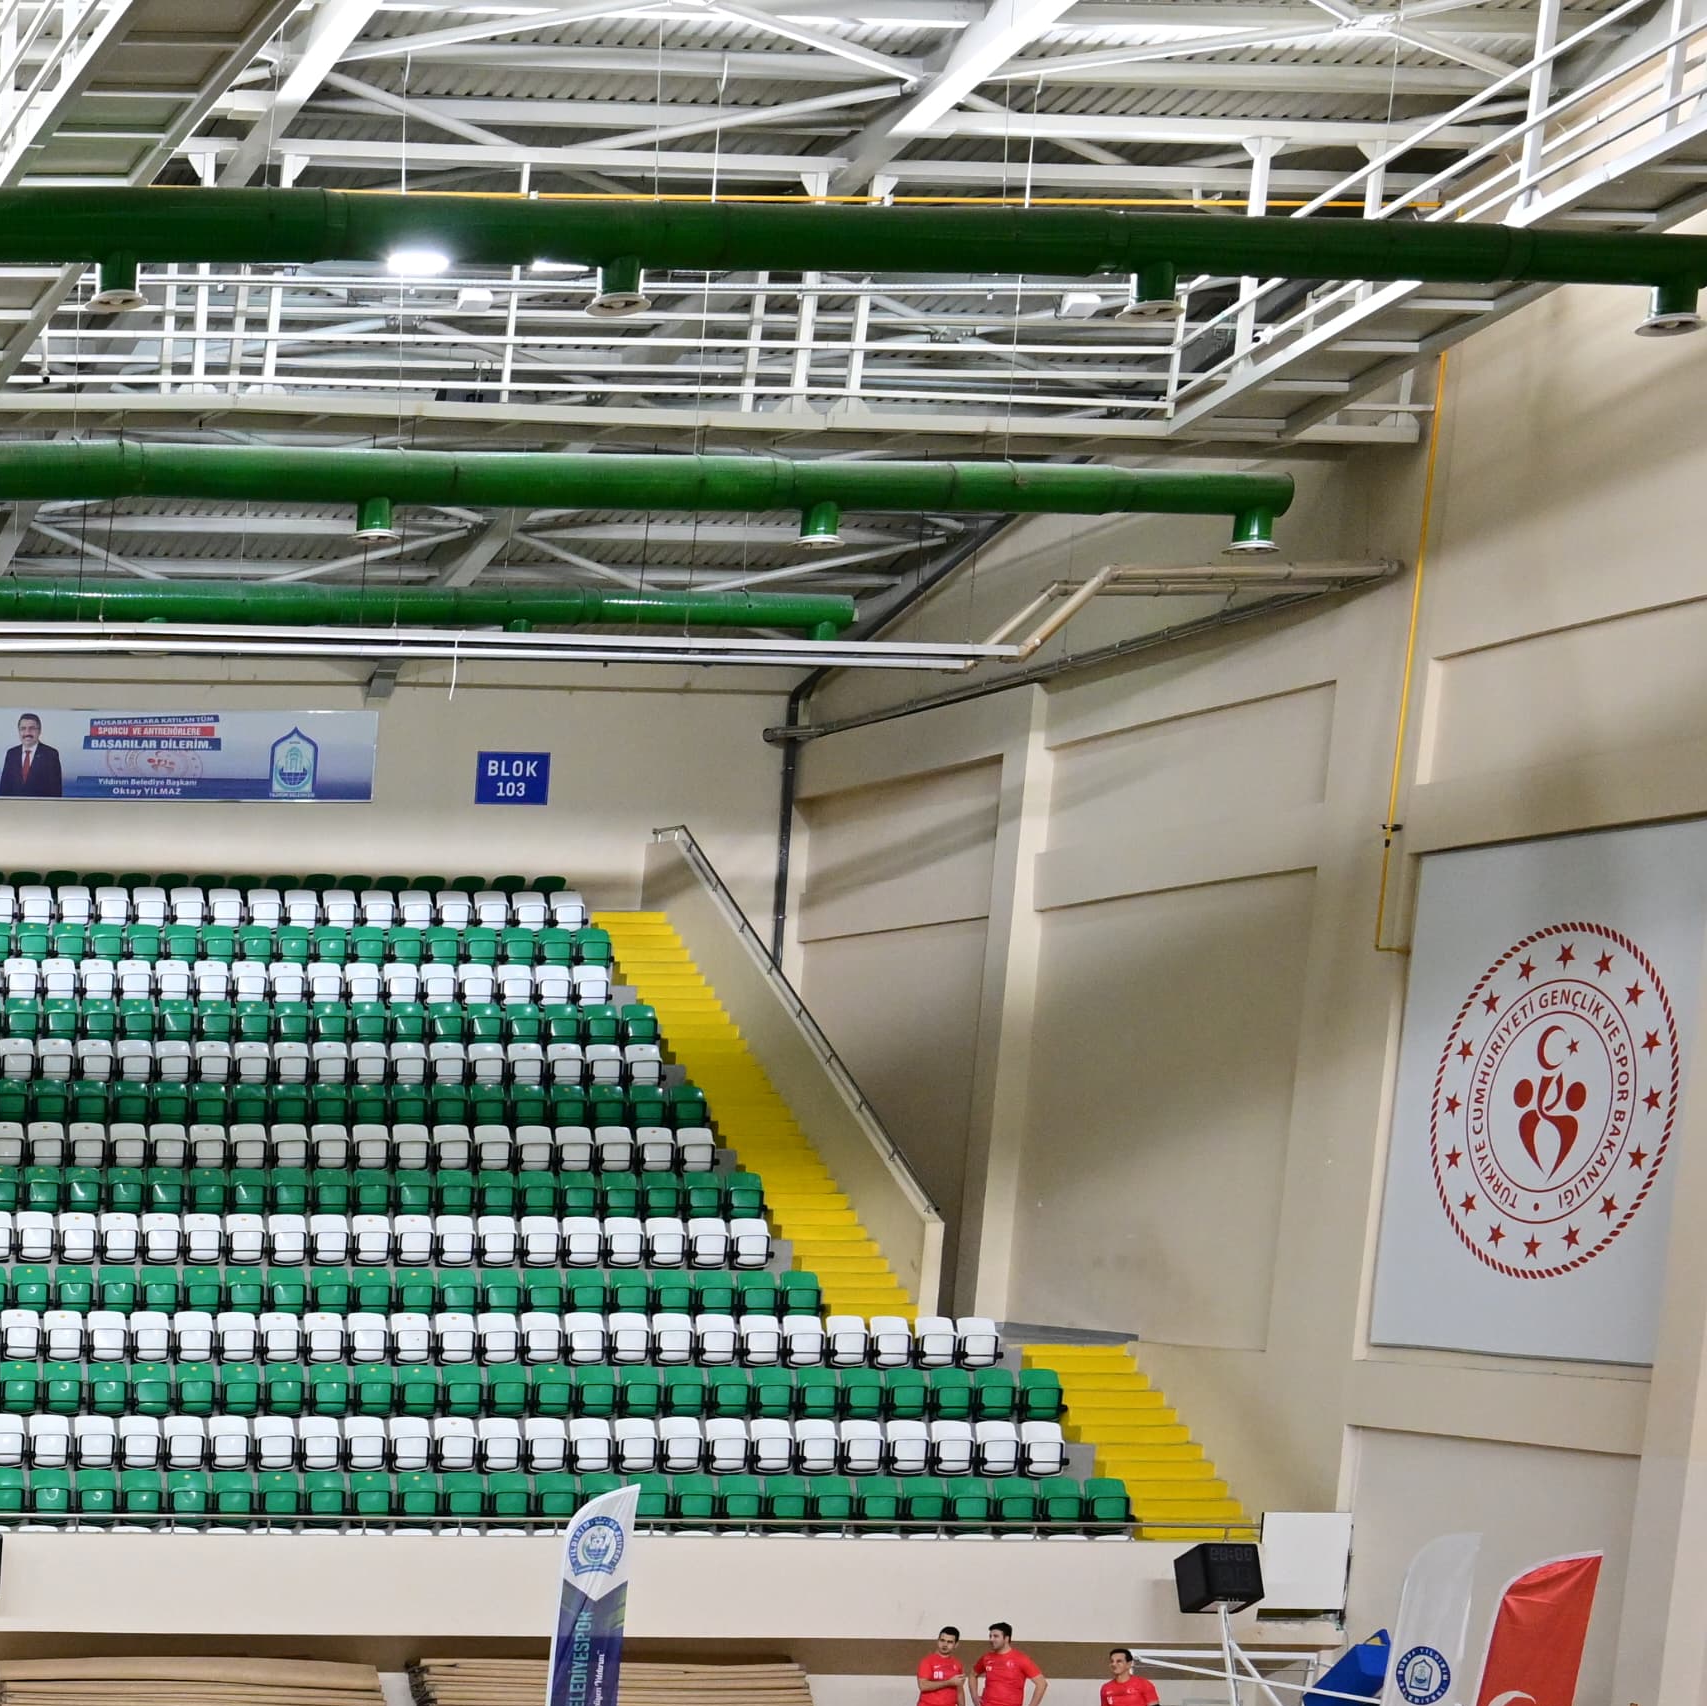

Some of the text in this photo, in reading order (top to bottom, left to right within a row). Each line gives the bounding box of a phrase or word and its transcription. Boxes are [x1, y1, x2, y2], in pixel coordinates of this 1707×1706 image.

[97, 726, 201, 736] SPORCU VE ANTRENÖRLERE
[90, 737, 213, 750] BAŞARILAR DİLERİM.
[487, 759, 539, 777] BLOK
[98, 777, 197, 788] Yıldırım Belediye Başkanı
[495, 781, 527, 797] 103
[112, 787, 142, 797] Oktay
[1472, 988, 1630, 1210] TÜRKİYE CUMHURİYETİ GENÇLİK VE SPOR BAKANLIĞI
